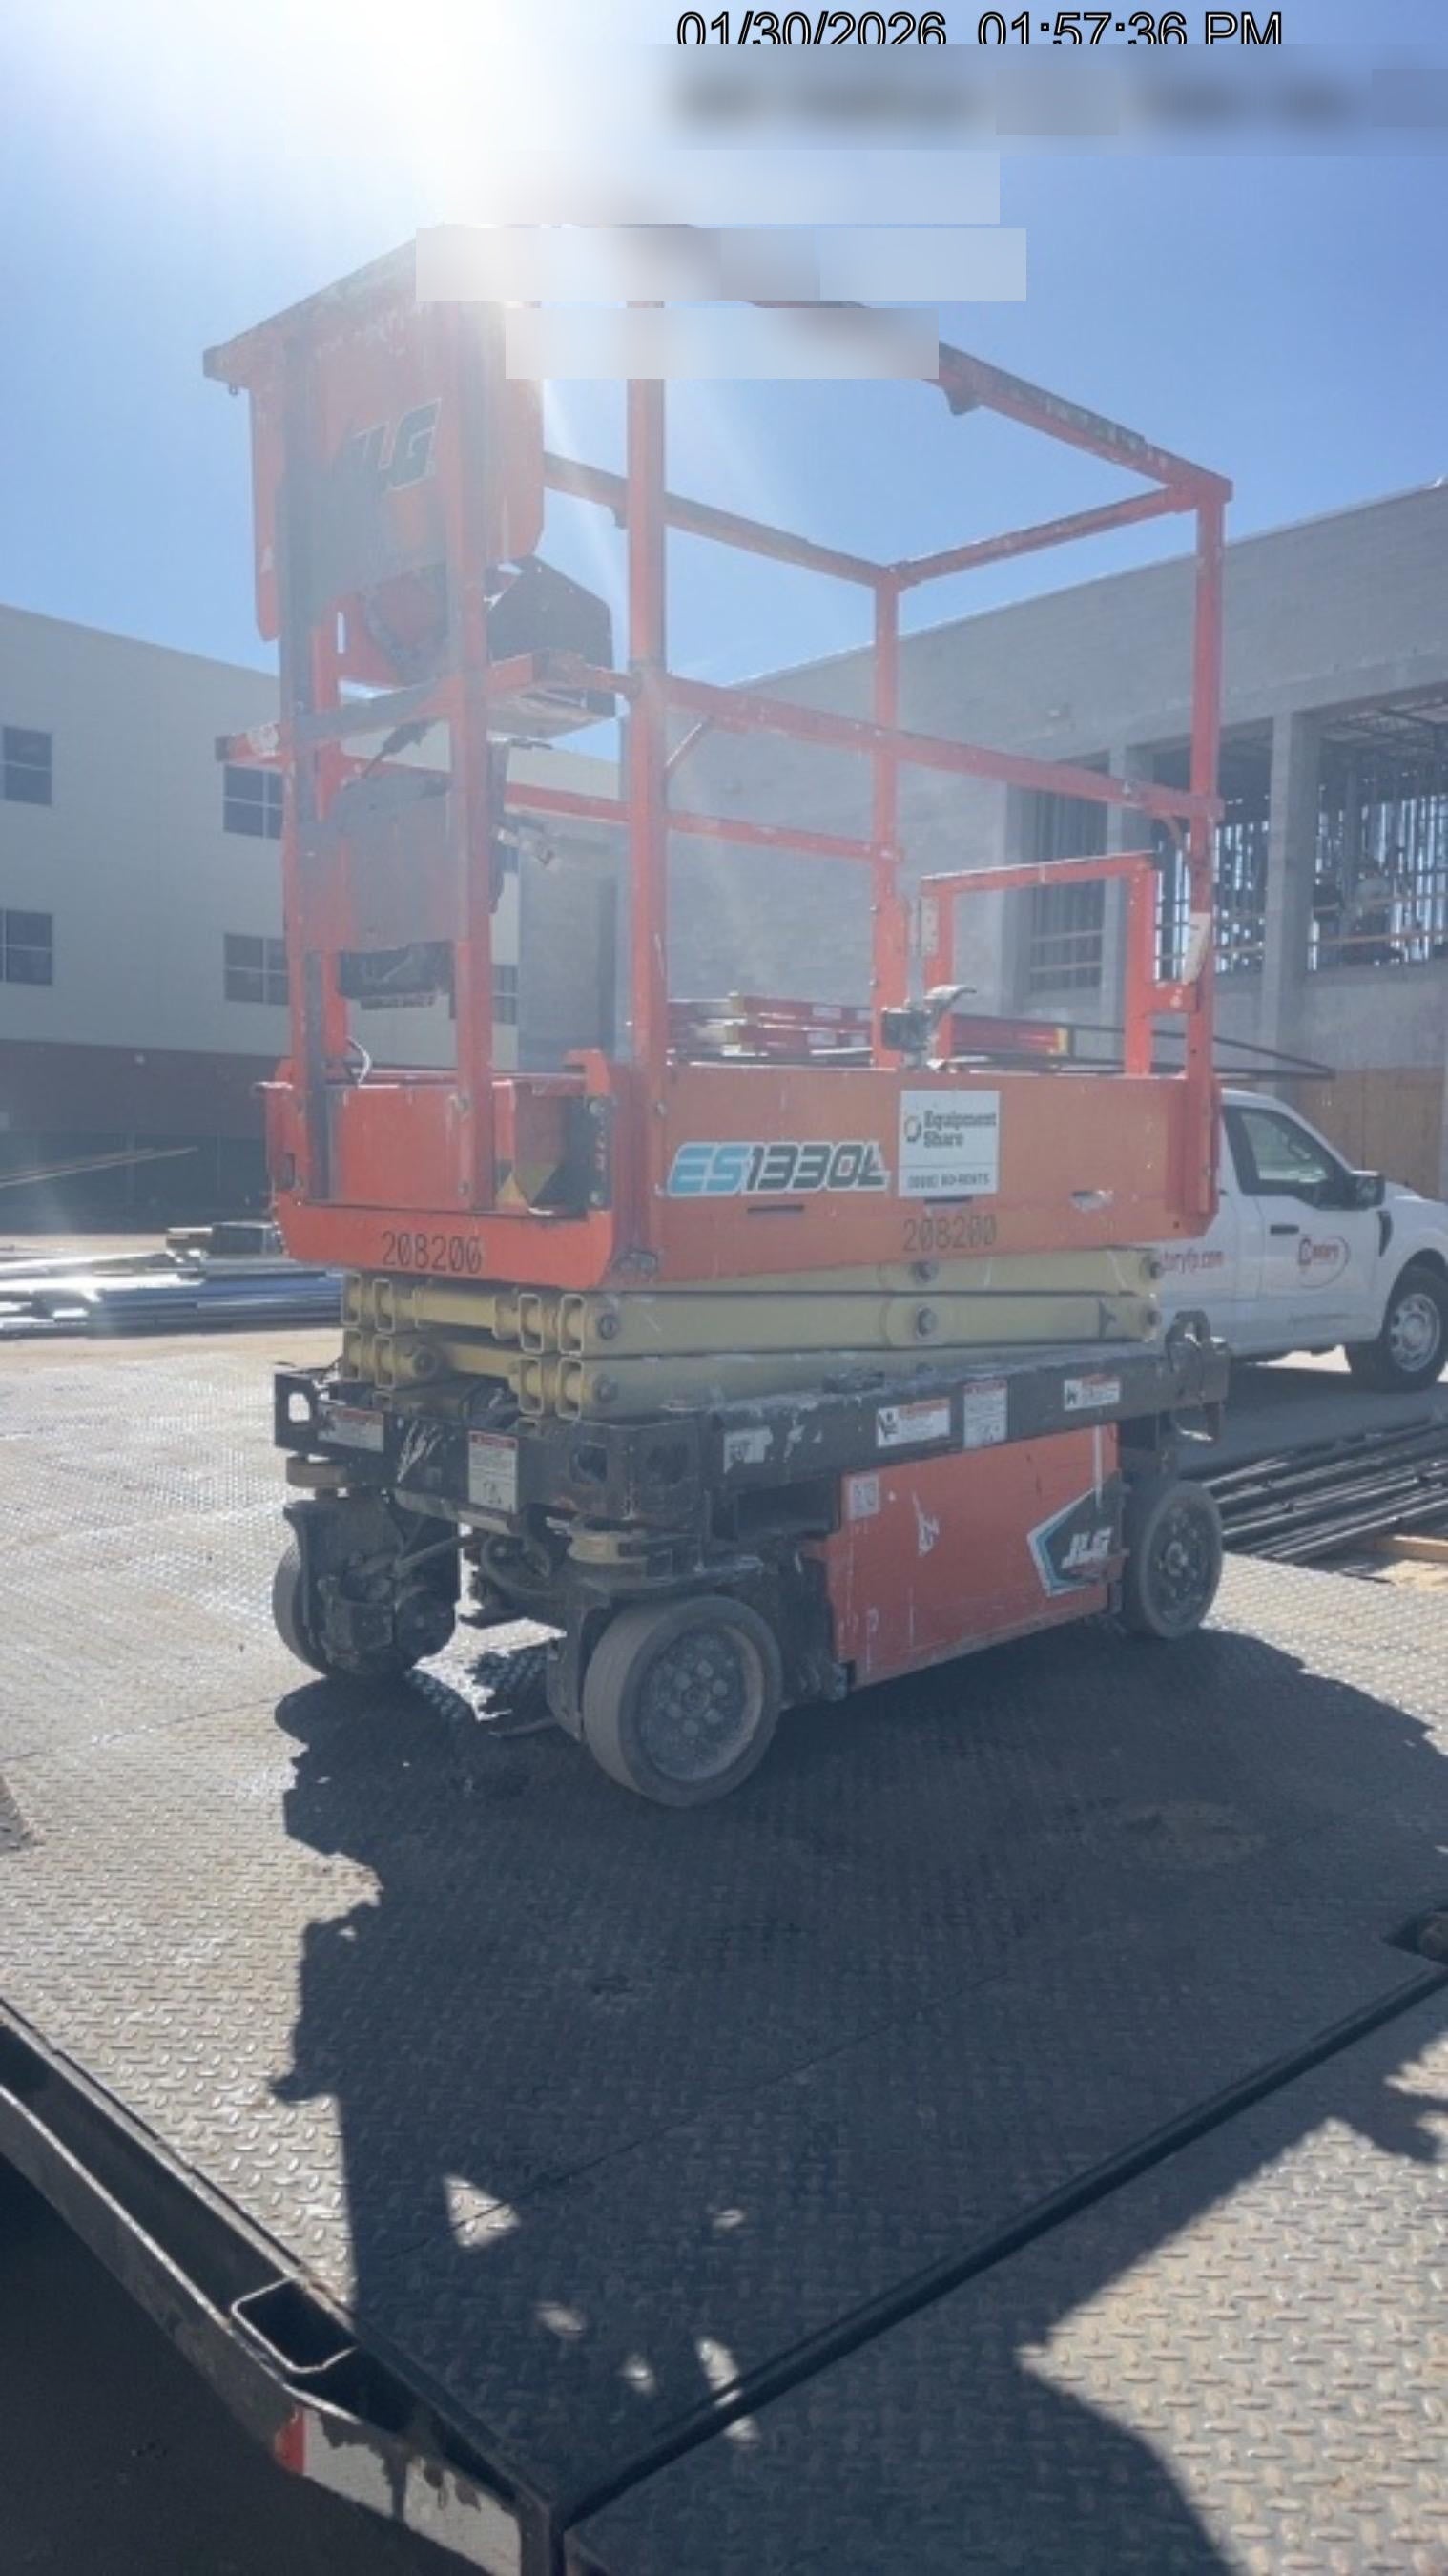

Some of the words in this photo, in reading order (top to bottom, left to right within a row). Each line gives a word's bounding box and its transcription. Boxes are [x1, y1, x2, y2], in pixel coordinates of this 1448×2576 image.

[924, 1110, 997, 1131] Equipment
[924, 1131, 963, 1148] Share
[668, 1141, 890, 1196] ES1330L
[382, 1230, 482, 1274] 208200
[902, 1215, 997, 1252] 208200
[1060, 1527, 1111, 1569] JLG
